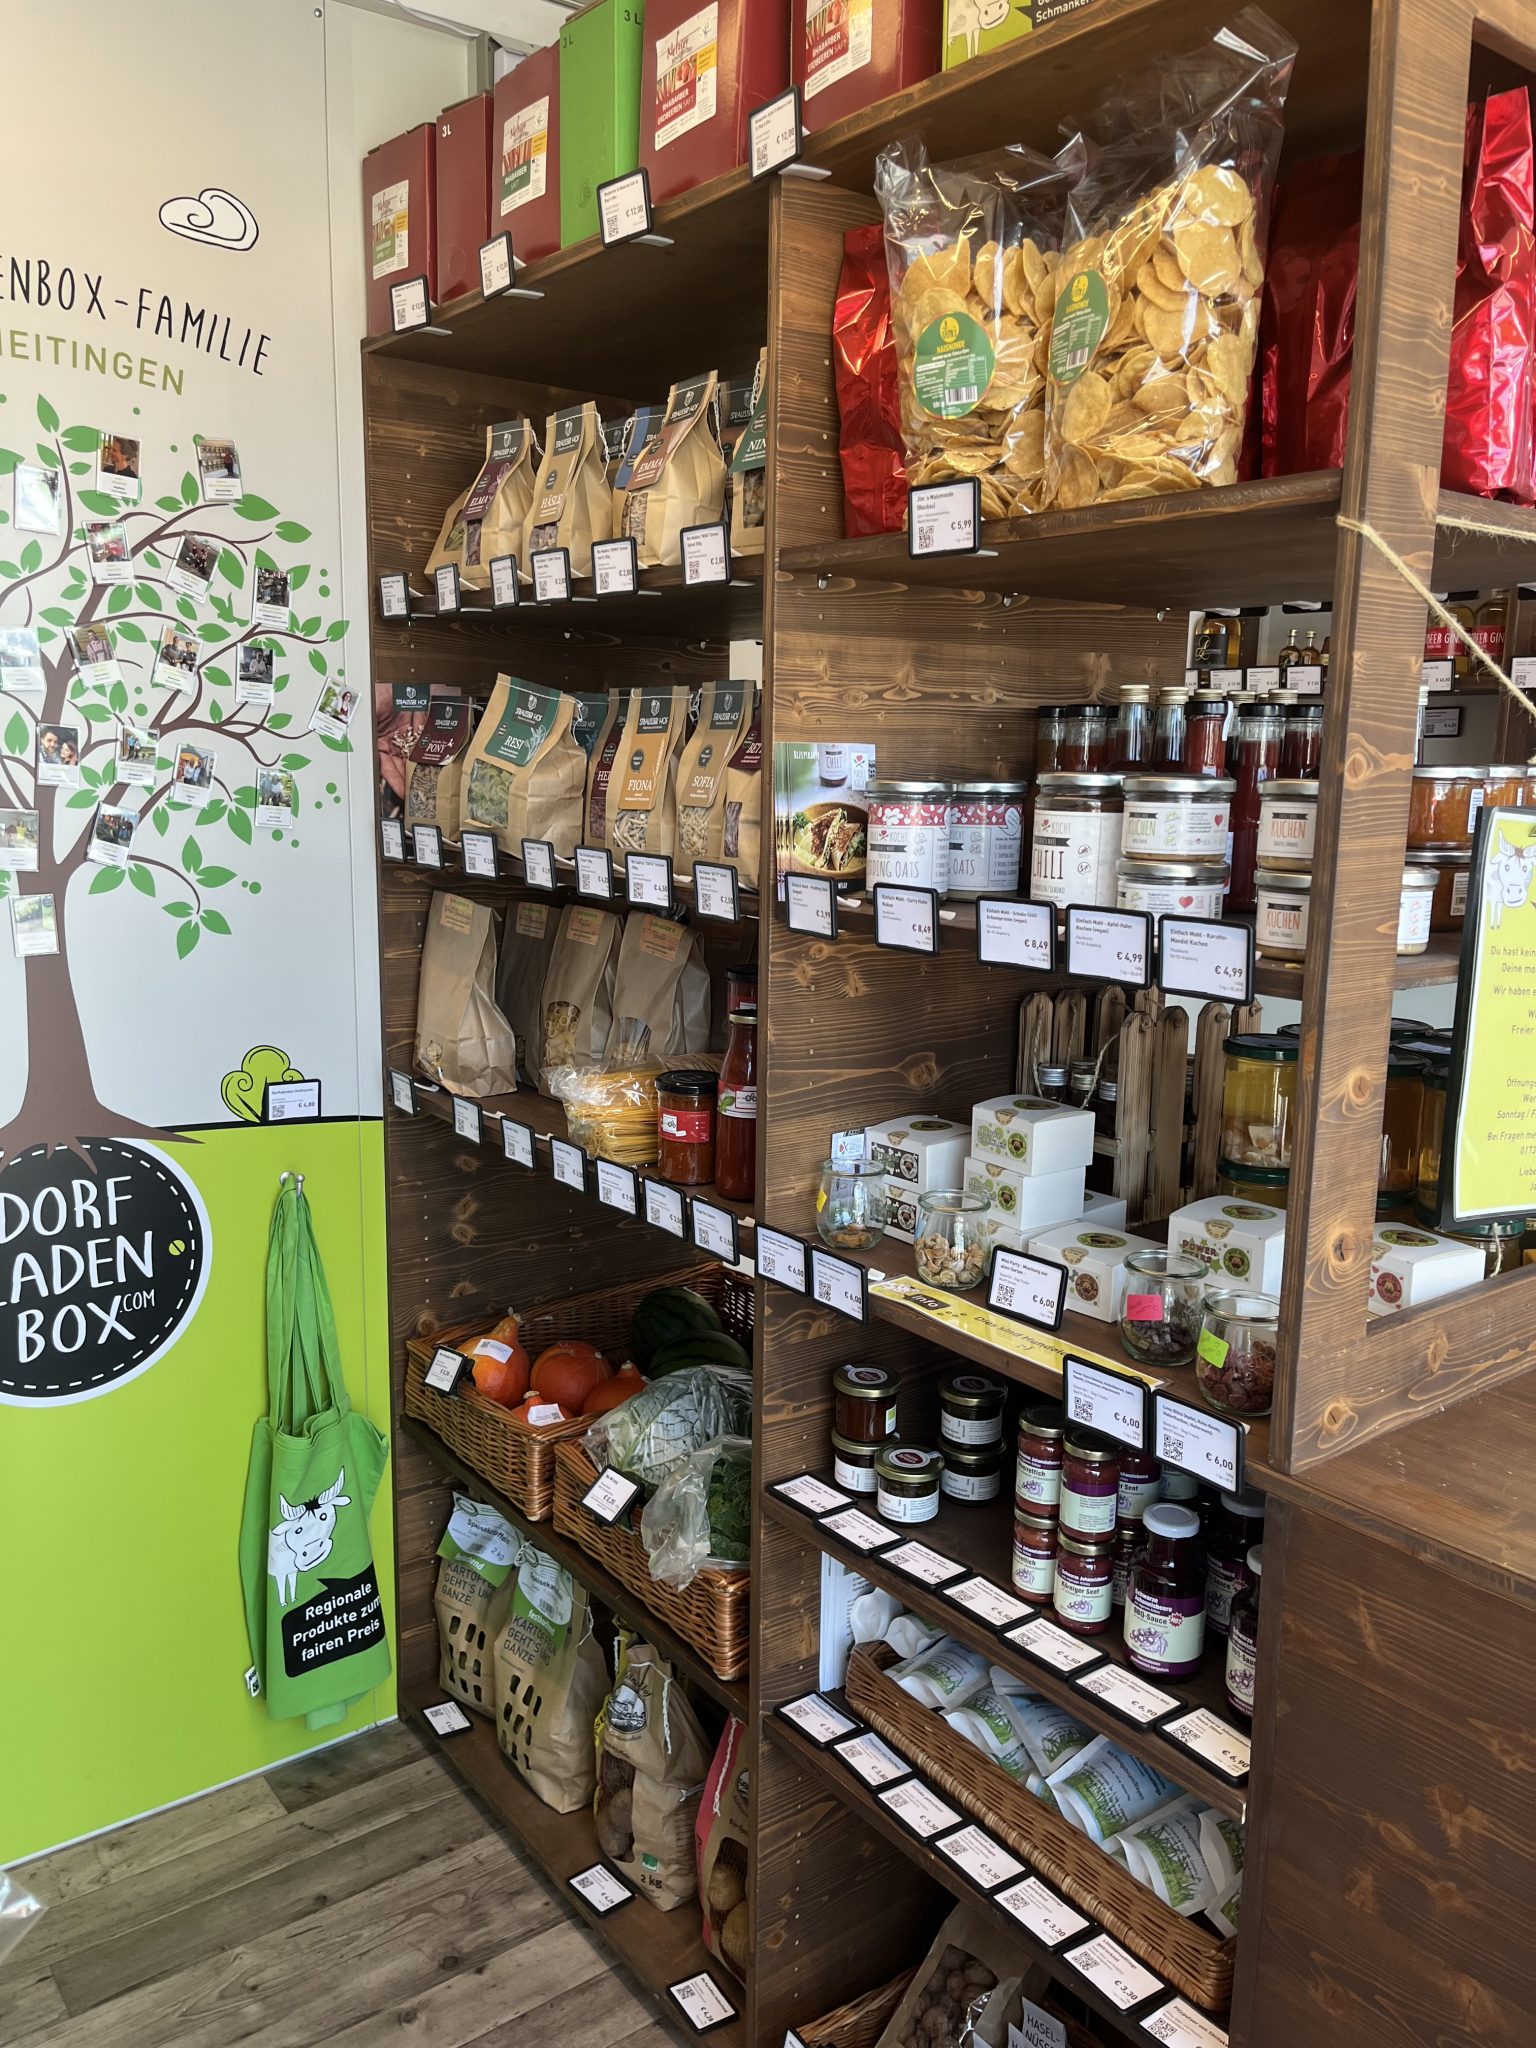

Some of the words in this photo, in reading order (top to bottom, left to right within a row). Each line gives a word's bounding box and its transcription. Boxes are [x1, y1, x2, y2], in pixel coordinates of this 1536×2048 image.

[624, 11, 631, 21] 3
[634, 16, 642, 25] L
[776, 135, 779, 144] €
[0, 256, 272, 375] NBOX-FAMILIE
[0, 330, 185, 396] EITINGEN
[638, 459, 662, 474] EMMA
[951, 522, 955, 530] €
[957, 519, 971, 529] 5,99
[426, 743, 446, 753] PONY
[505, 736, 524, 750] RESI
[628, 779, 652, 791] FIONA
[692, 776, 714, 788] SOFIA
[1128, 820, 1156, 836] KUCHEN
[1271, 821, 1306, 839] KUCHEN
[895, 860, 919, 878] OATS
[954, 858, 974, 876] OATS
[912, 923, 916, 931] €
[918, 924, 930, 933] 8,49
[1266, 912, 1300, 930] KUCHEN
[1024, 939, 1029, 947] €
[1031, 939, 1047, 949] 8,49
[1491, 946, 1500, 955] Du
[1503, 948, 1518, 956] hast
[1116, 951, 1121, 960] €
[1124, 952, 1142, 963] 4,99
[1215, 965, 1220, 974] €
[1223, 966, 1242, 978] 4,99
[1502, 963, 1522, 972] Deine
[1494, 986, 1506, 994] Wir
[1509, 987, 1530, 996] haben
[1512, 1025, 1534, 1035] Freier
[1497, 1111, 1525, 1120] Sonntag
[0, 1175, 132, 1244] DORF
[1182, 1240, 1217, 1256] POWER
[0, 1230, 153, 1304] ADEN
[849, 1293, 861, 1304] 6,00
[1032, 1294, 1037, 1302] €
[1039, 1296, 1054, 1309] 6,00
[17, 1295, 136, 1364] BOX
[999, 1326, 1023, 1338] sind
[1114, 1412, 1119, 1420] €
[1122, 1414, 1139, 1429] 6,00
[1206, 1451, 1211, 1461] €
[1214, 1455, 1232, 1471] 6,00
[497, 1550, 505, 1561] kg
[444, 1573, 475, 1594] GEHT'S
[1061, 1581, 1084, 1594] Körniger
[306, 1580, 372, 1621] Regionale
[1135, 1588, 1158, 1603] Schwarze
[1135, 1595, 1172, 1612] Johannisbeere
[292, 1611, 357, 1647] Produkte
[361, 1595, 381, 1617] zum
[995, 1610, 1013, 1620] 4,50
[1134, 1607, 1167, 1624] BBQ-Sauce
[302, 1636, 344, 1662] fairen
[348, 1619, 380, 1644] Preis
[507, 1628, 540, 1652] GEHT'S
[1061, 1654, 1081, 1665] 4,50
[1137, 1705, 1158, 1716] 6,90
[823, 1726, 837, 1736] 3,30
[1228, 1754, 1250, 1768] 6,90
[923, 1818, 939, 1831] 3,30
[984, 1867, 1000, 1880] 3,30
[640, 1874, 646, 1883] 2
[649, 1875, 662, 1889] kg
[1048, 1923, 1066, 1937] 3,30
[1096, 1942, 1120, 1962] getrocknet
[1119, 1985, 1138, 2000] 3,30
[1027, 2013, 1060, 2043] HASEL-
